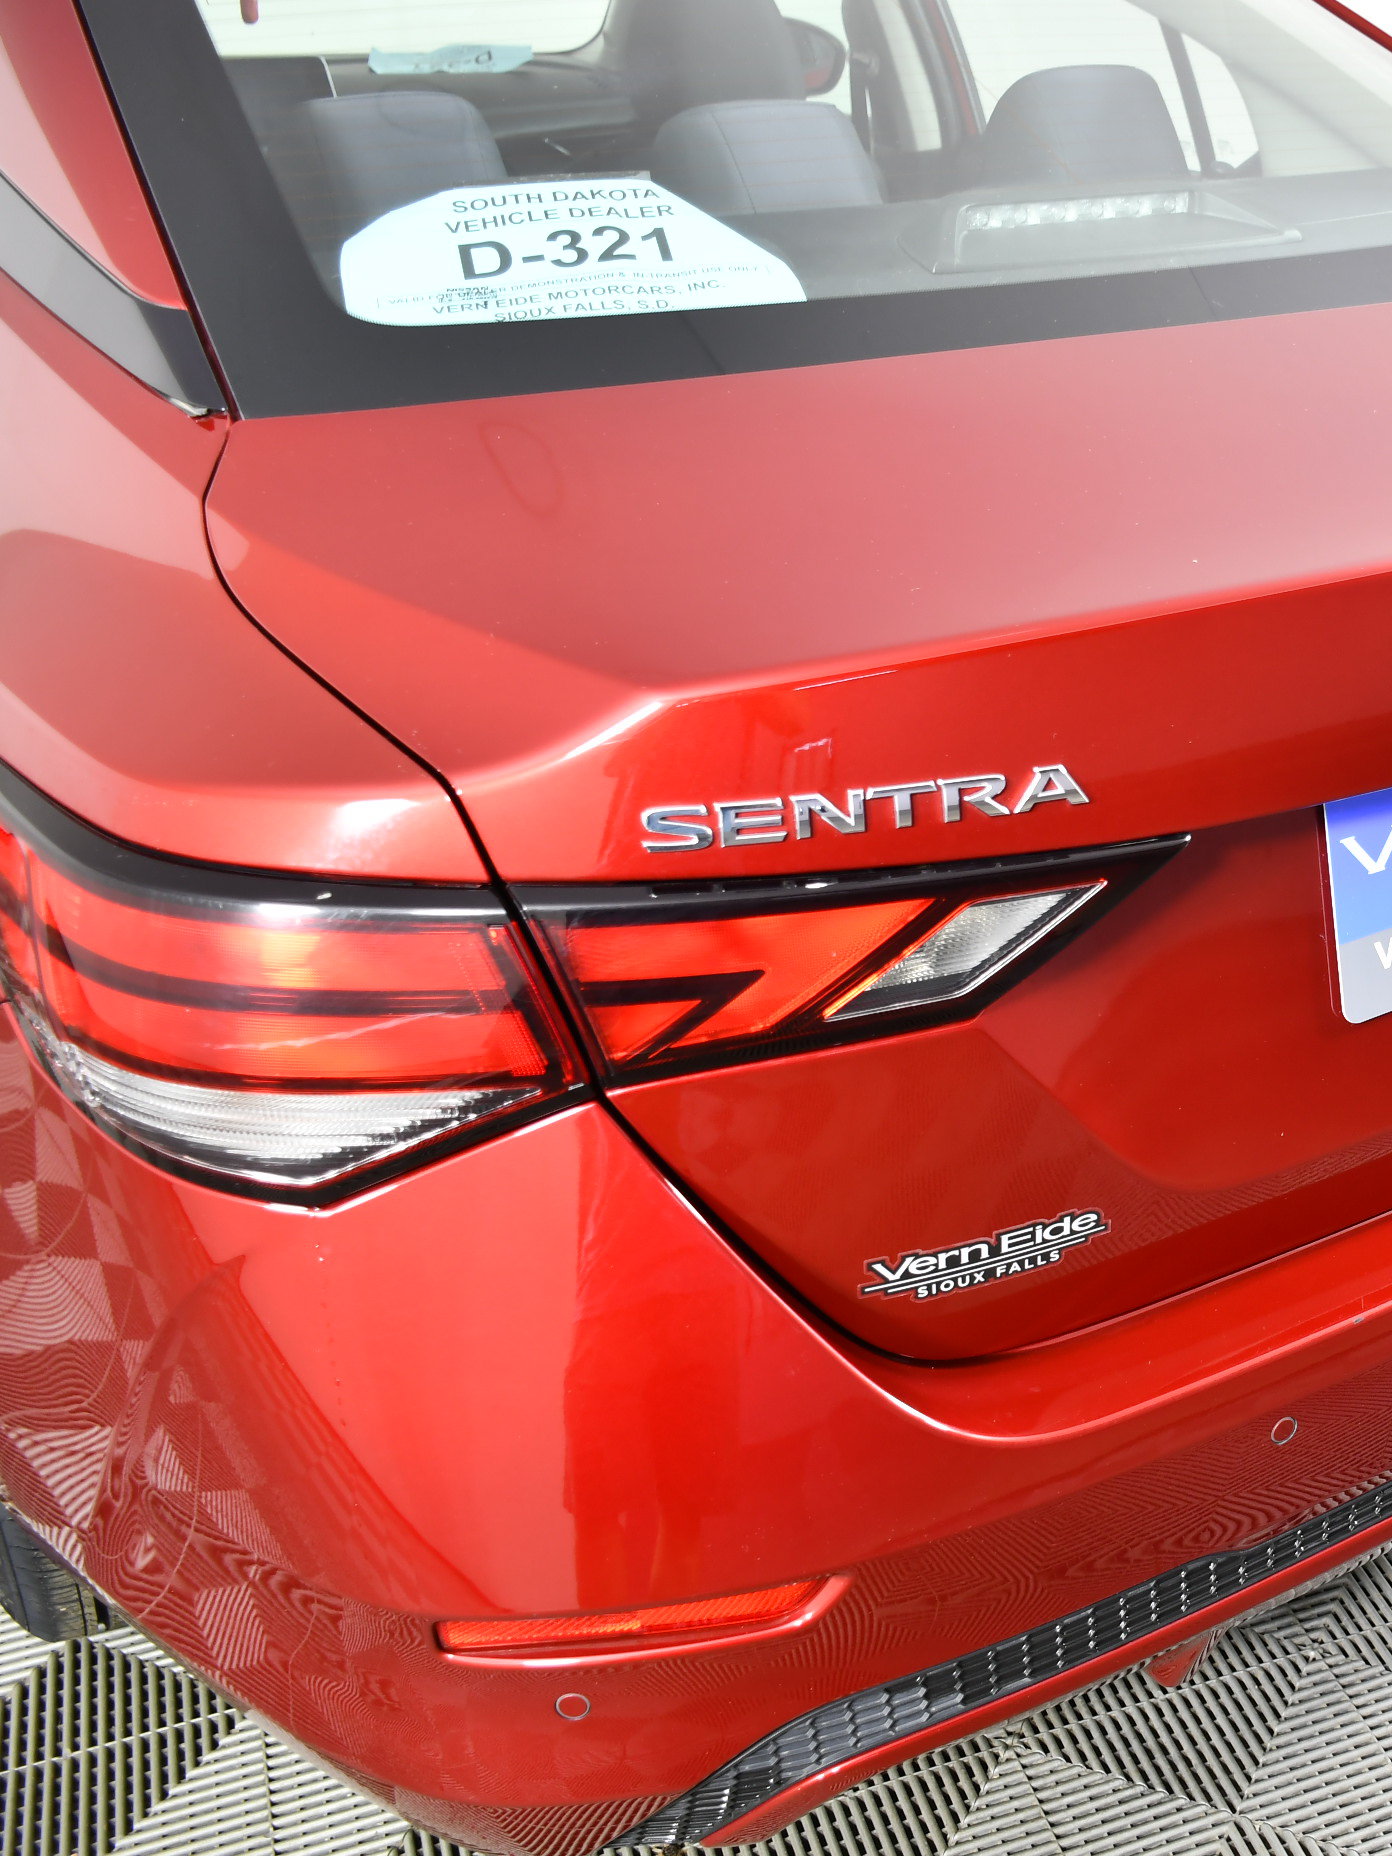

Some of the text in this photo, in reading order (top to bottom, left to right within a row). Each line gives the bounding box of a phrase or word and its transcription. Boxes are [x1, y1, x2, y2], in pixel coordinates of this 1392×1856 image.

[445, 204, 674, 234] VEHICLE DEALER
[452, 188, 660, 213] SOUTH DAKOTA
[457, 225, 674, 281] D-321
[432, 300, 489, 315] VERN
[495, 294, 541, 308] EIDE
[548, 284, 682, 300] MOTORCARS,
[687, 279, 727, 292] INC.
[494, 299, 675, 321] SIOUX FALLS, S.D.
[640, 763, 1090, 854] SENTRA
[872, 1211, 1099, 1282] Vern Eide
[917, 1249, 1061, 1299] SIOUX FALLS
